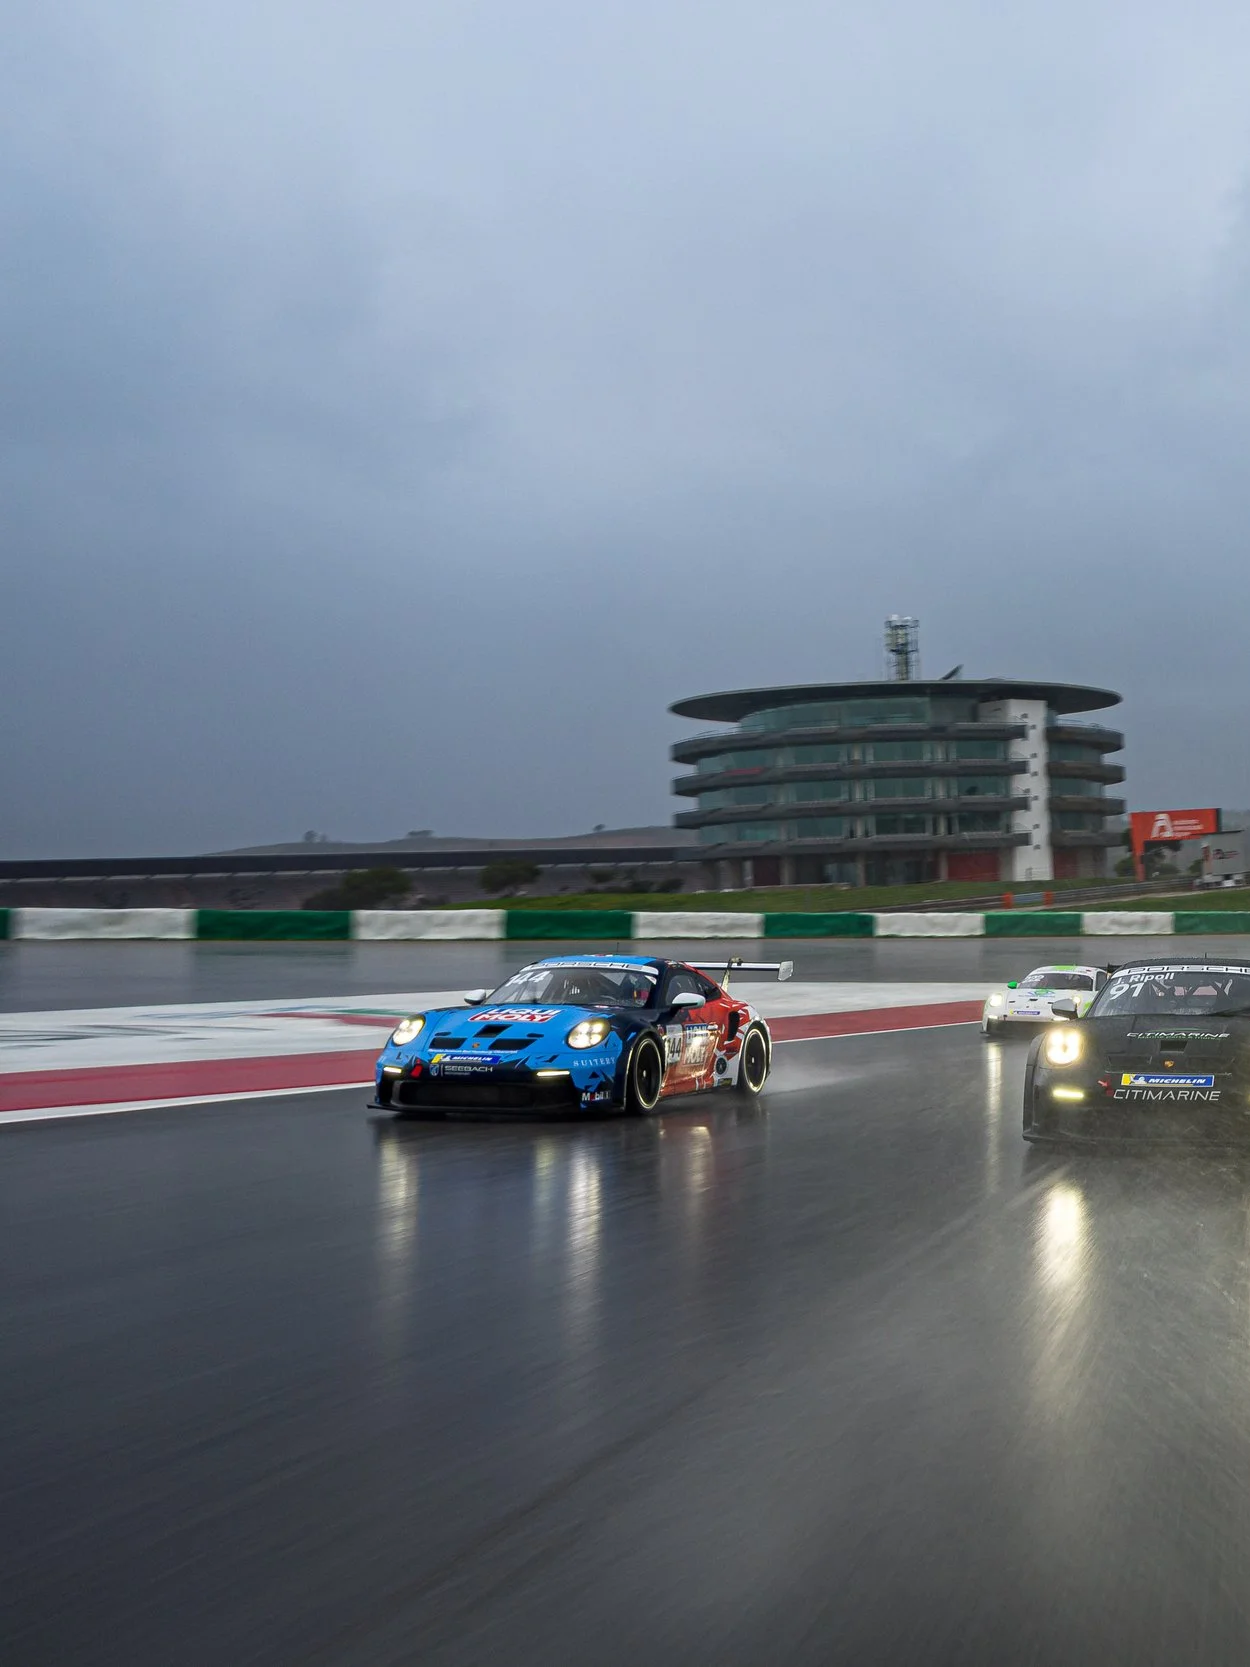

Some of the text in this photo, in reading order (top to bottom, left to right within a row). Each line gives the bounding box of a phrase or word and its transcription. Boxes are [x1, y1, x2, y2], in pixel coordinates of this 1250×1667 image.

[505, 971, 550, 987] 144
[1113, 972, 1175, 986] J. Ripoll
[1109, 982, 1145, 1000] 91
[573, 1057, 615, 1067] SUITERY
[1113, 1089, 1221, 1101] CITIMARINE
